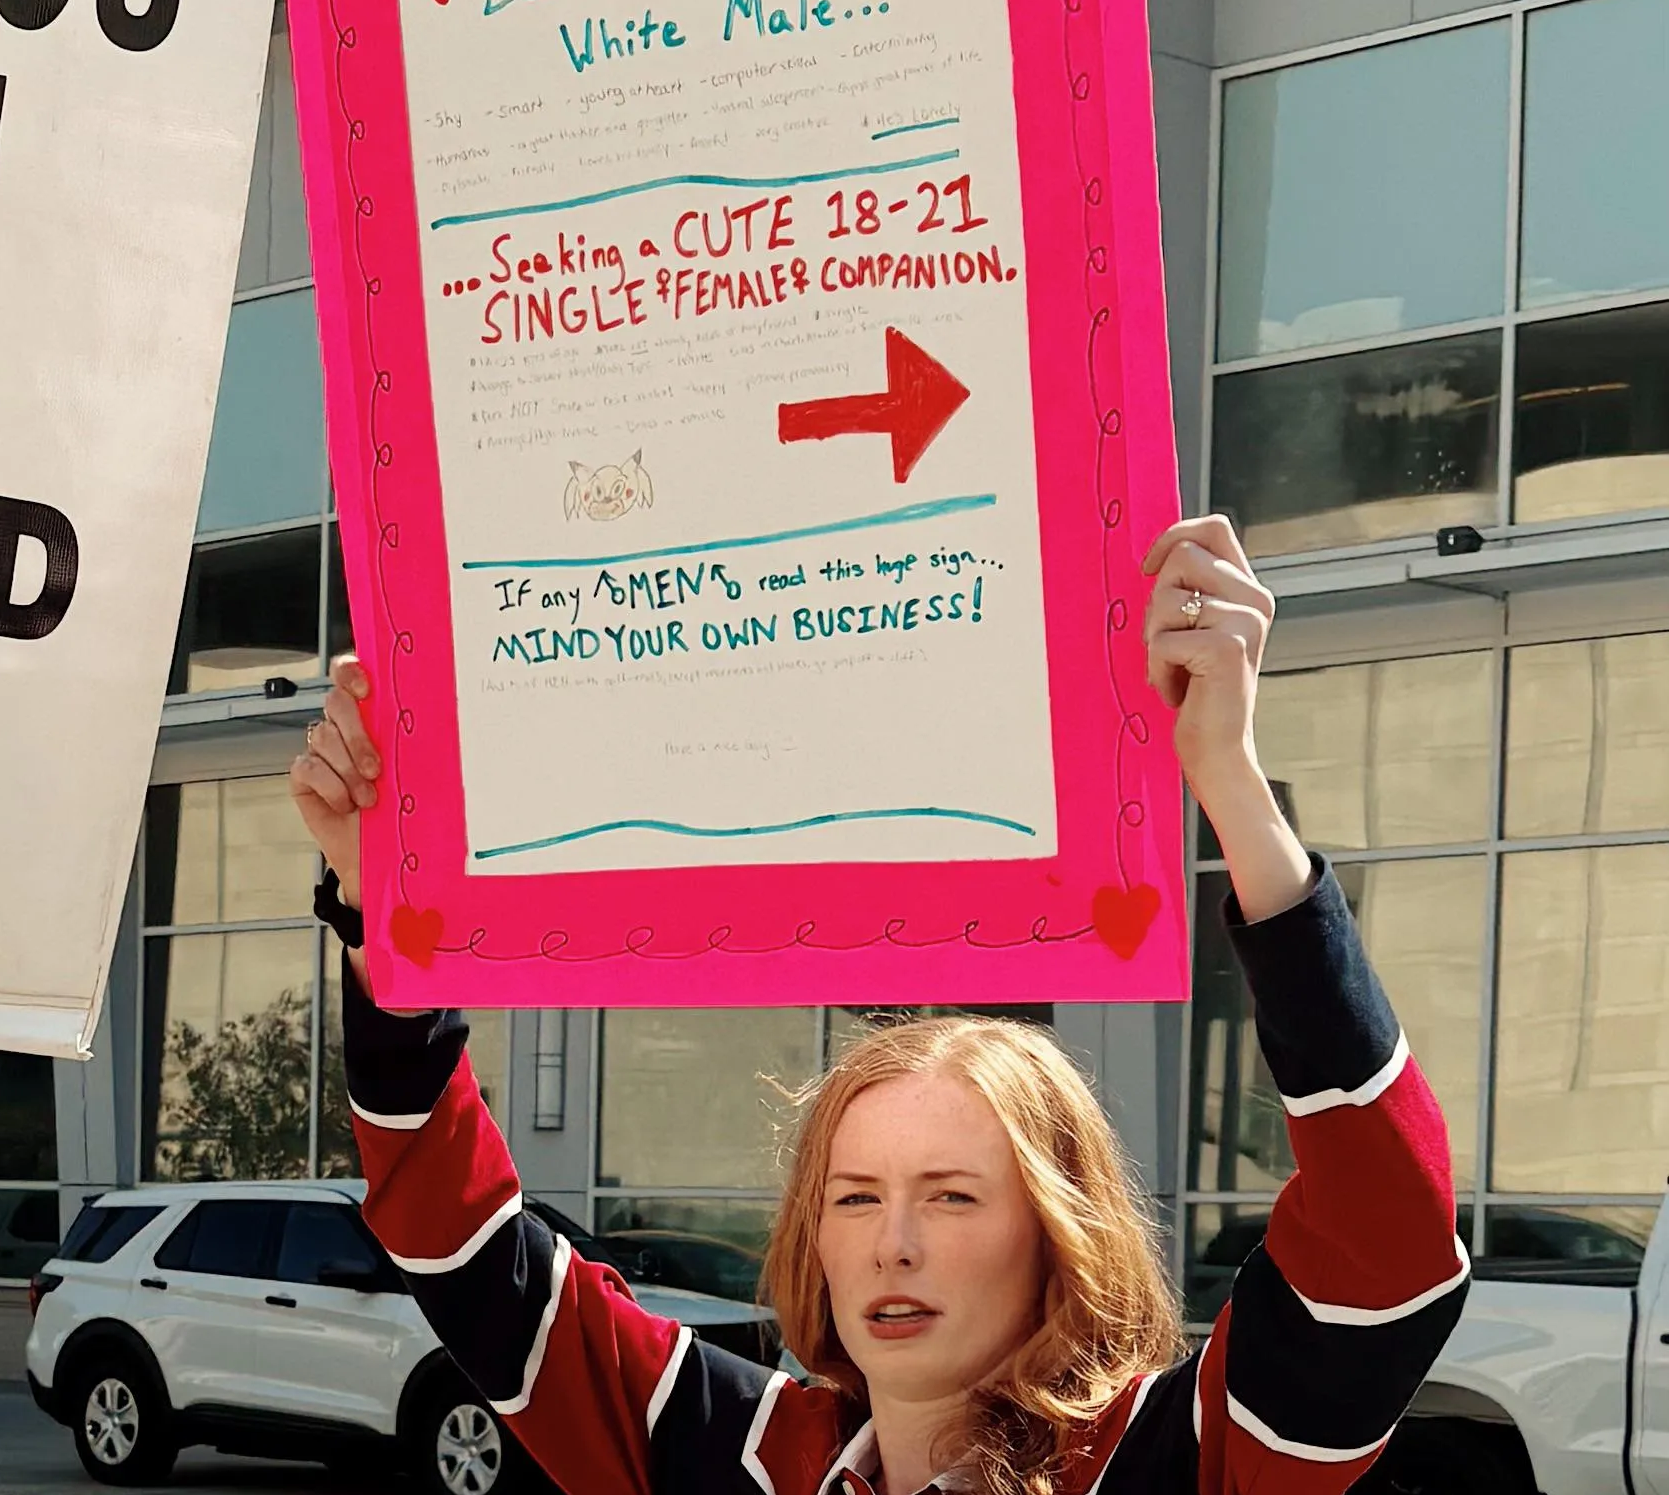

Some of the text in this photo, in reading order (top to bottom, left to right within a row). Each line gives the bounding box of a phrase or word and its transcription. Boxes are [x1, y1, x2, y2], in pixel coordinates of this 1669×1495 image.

[560, 8, 687, 74] White
[639, 236, 660, 260] a
[673, 194, 796, 260] CUTE
[828, 173, 989, 241] 18-21
[481, 278, 648, 345] SINGLE
[820, 245, 1019, 293] COMPANION.
[492, 576, 985, 665] MIND YOUR OWN BUSINESS!
[541, 589, 581, 624] any
[629, 563, 706, 610] MEN
[759, 565, 808, 593] read
[819, 548, 864, 580] this
[874, 552, 918, 583] huge
